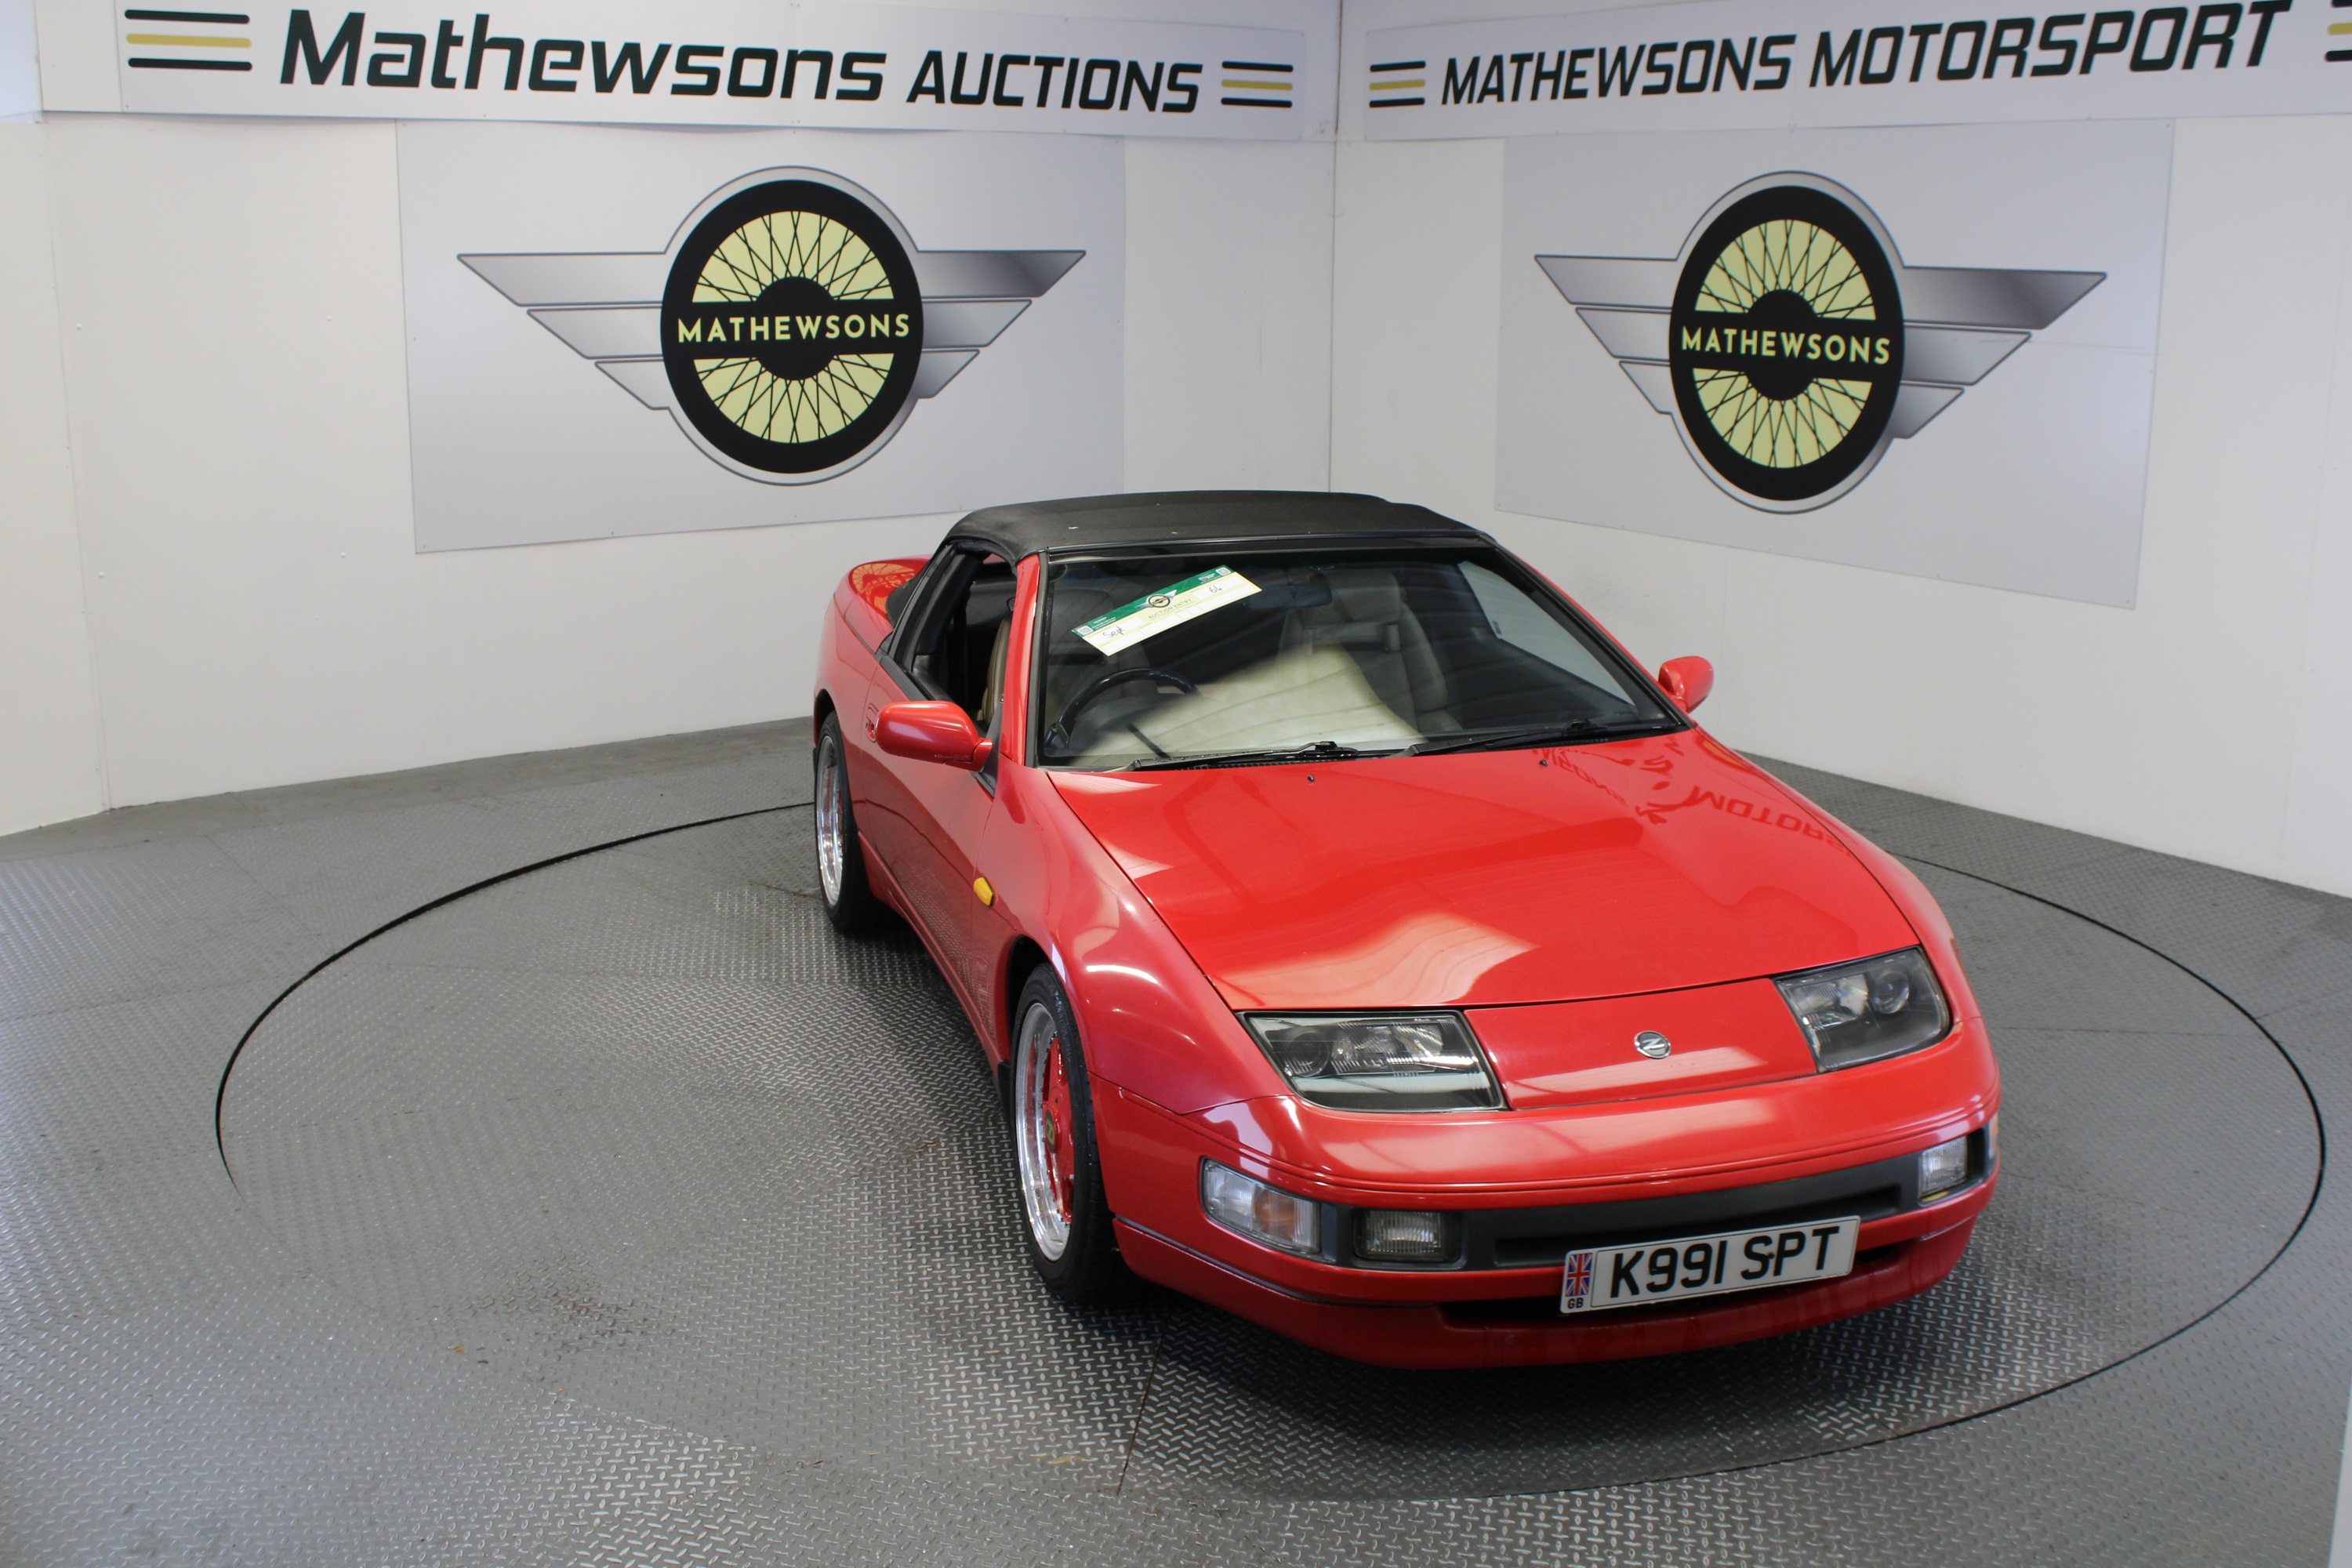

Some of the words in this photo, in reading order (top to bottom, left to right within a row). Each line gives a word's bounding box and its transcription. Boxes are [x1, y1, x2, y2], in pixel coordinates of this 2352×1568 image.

[280, 9, 887, 101] Mathewsons
[906, 50, 1203, 114] AUCTIONS
[1441, 34, 1797, 105] MATHEWSONS
[1809, 0, 2293, 88] MOTORSPORT
[677, 314, 910, 343] MATHEWSONS
[1682, 326, 1891, 365] MATHEWSONS
[1149, 605, 1174, 619] AUCTION
[1174, 598, 1192, 608] ENTRY
[1610, 1240, 1728, 1299] K991
[1740, 1225, 1841, 1280] SPT
[1567, 1298, 1584, 1309] GB
